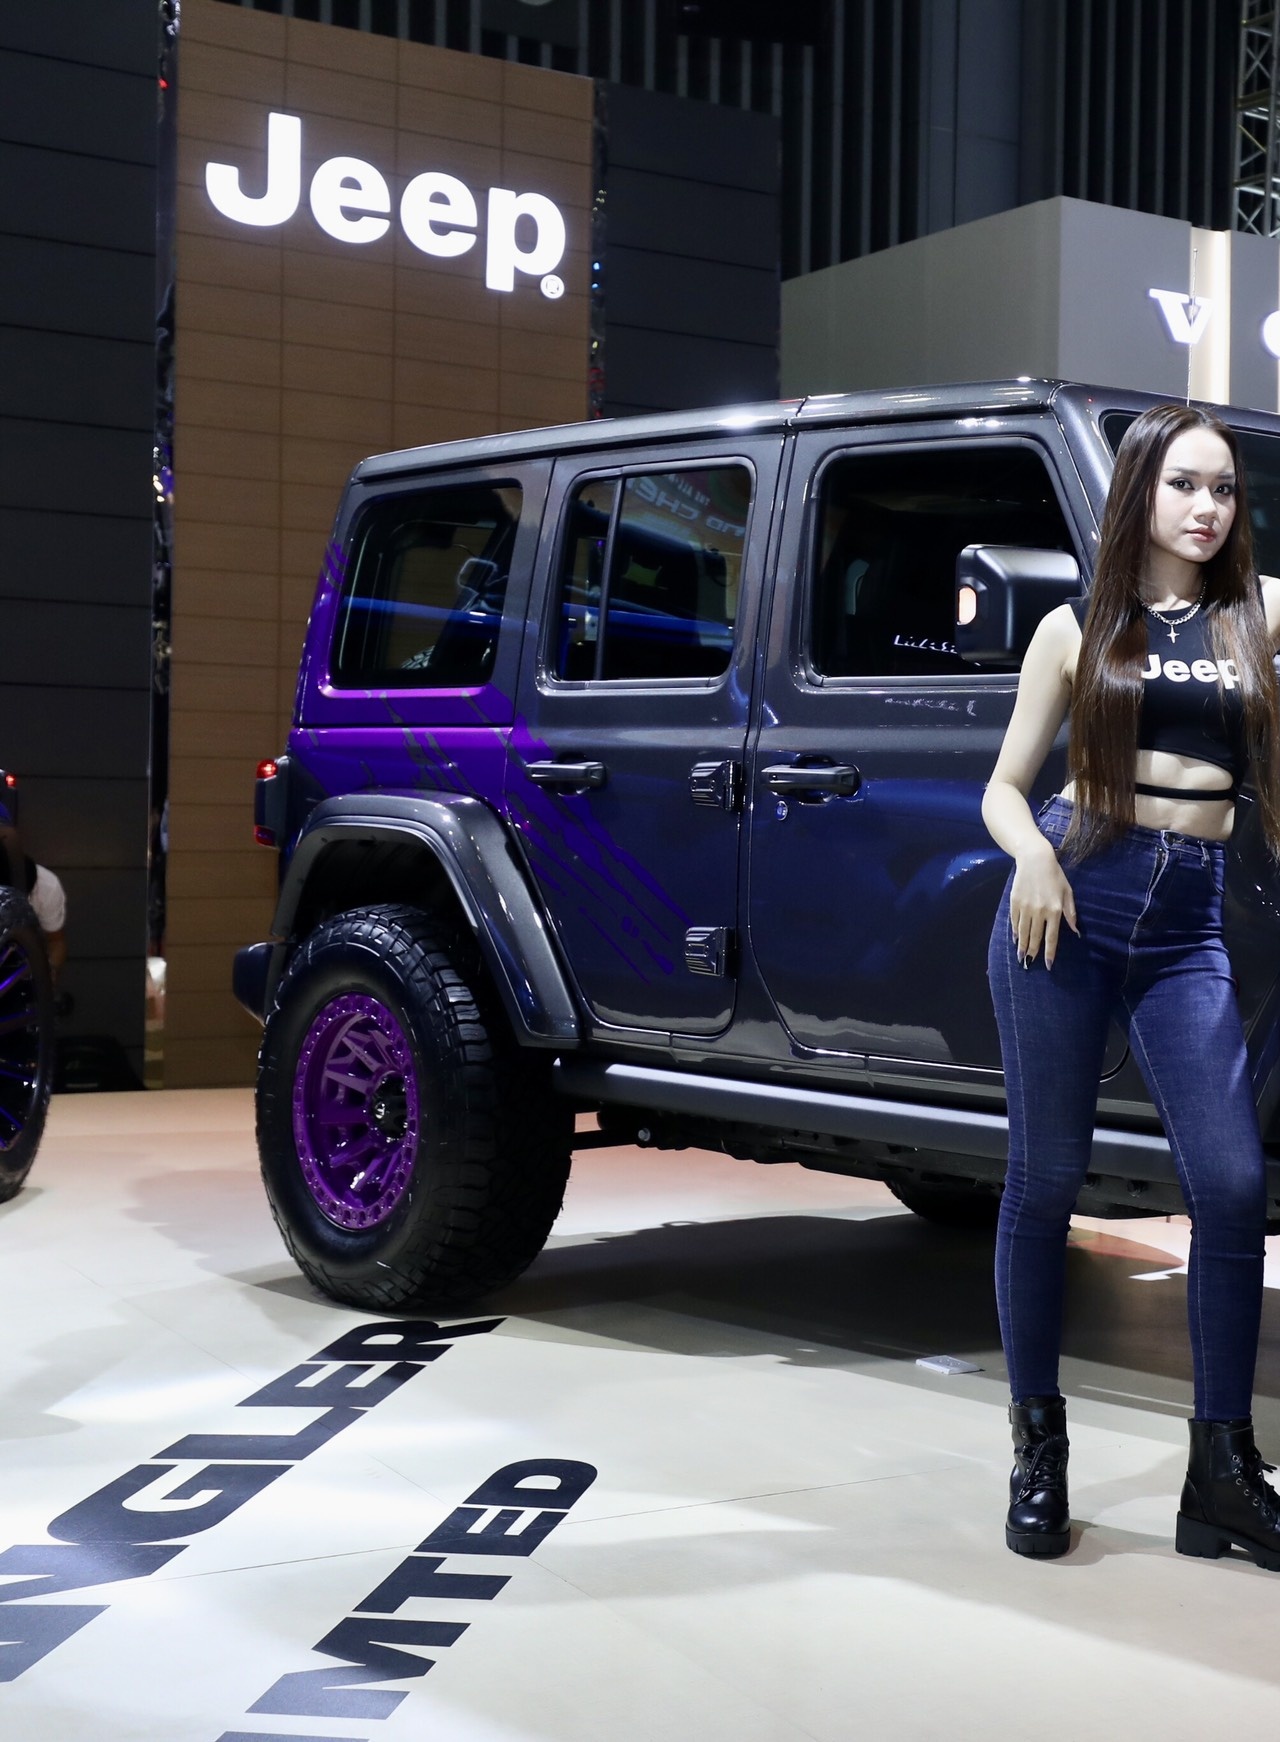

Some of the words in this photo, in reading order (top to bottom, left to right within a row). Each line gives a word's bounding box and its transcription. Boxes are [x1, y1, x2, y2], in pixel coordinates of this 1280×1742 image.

[205, 112, 566, 293] Jeep
[1141, 653, 1241, 690] Jeep
[0, 1317, 508, 1683] NGLER
